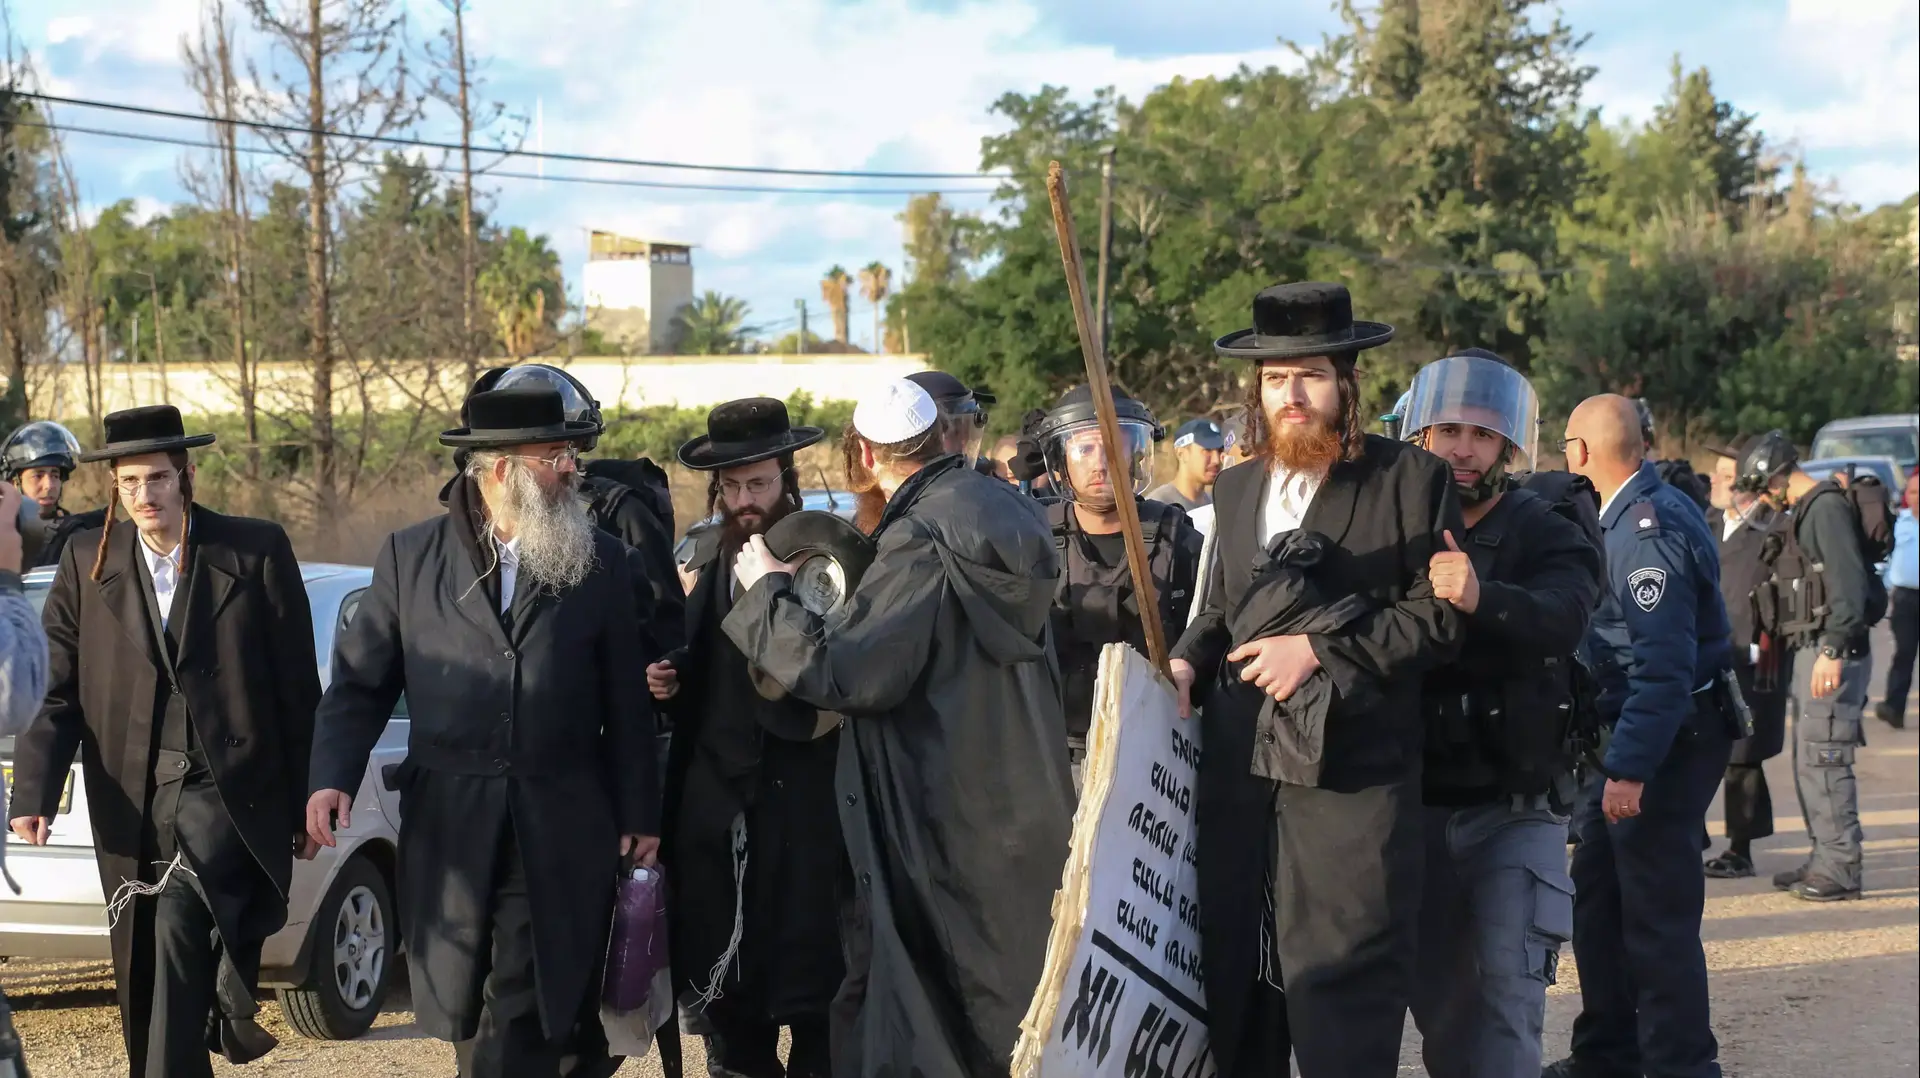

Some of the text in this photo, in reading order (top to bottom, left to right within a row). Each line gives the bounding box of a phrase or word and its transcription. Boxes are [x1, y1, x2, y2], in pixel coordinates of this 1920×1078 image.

[1150, 760, 1191, 816] מוחים
[1127, 802, 1179, 860] שבועות
[1178, 893, 1203, 932] מש
[1117, 899, 1204, 993] מדינת ישראל
[1061, 954, 1127, 1069] אנו
